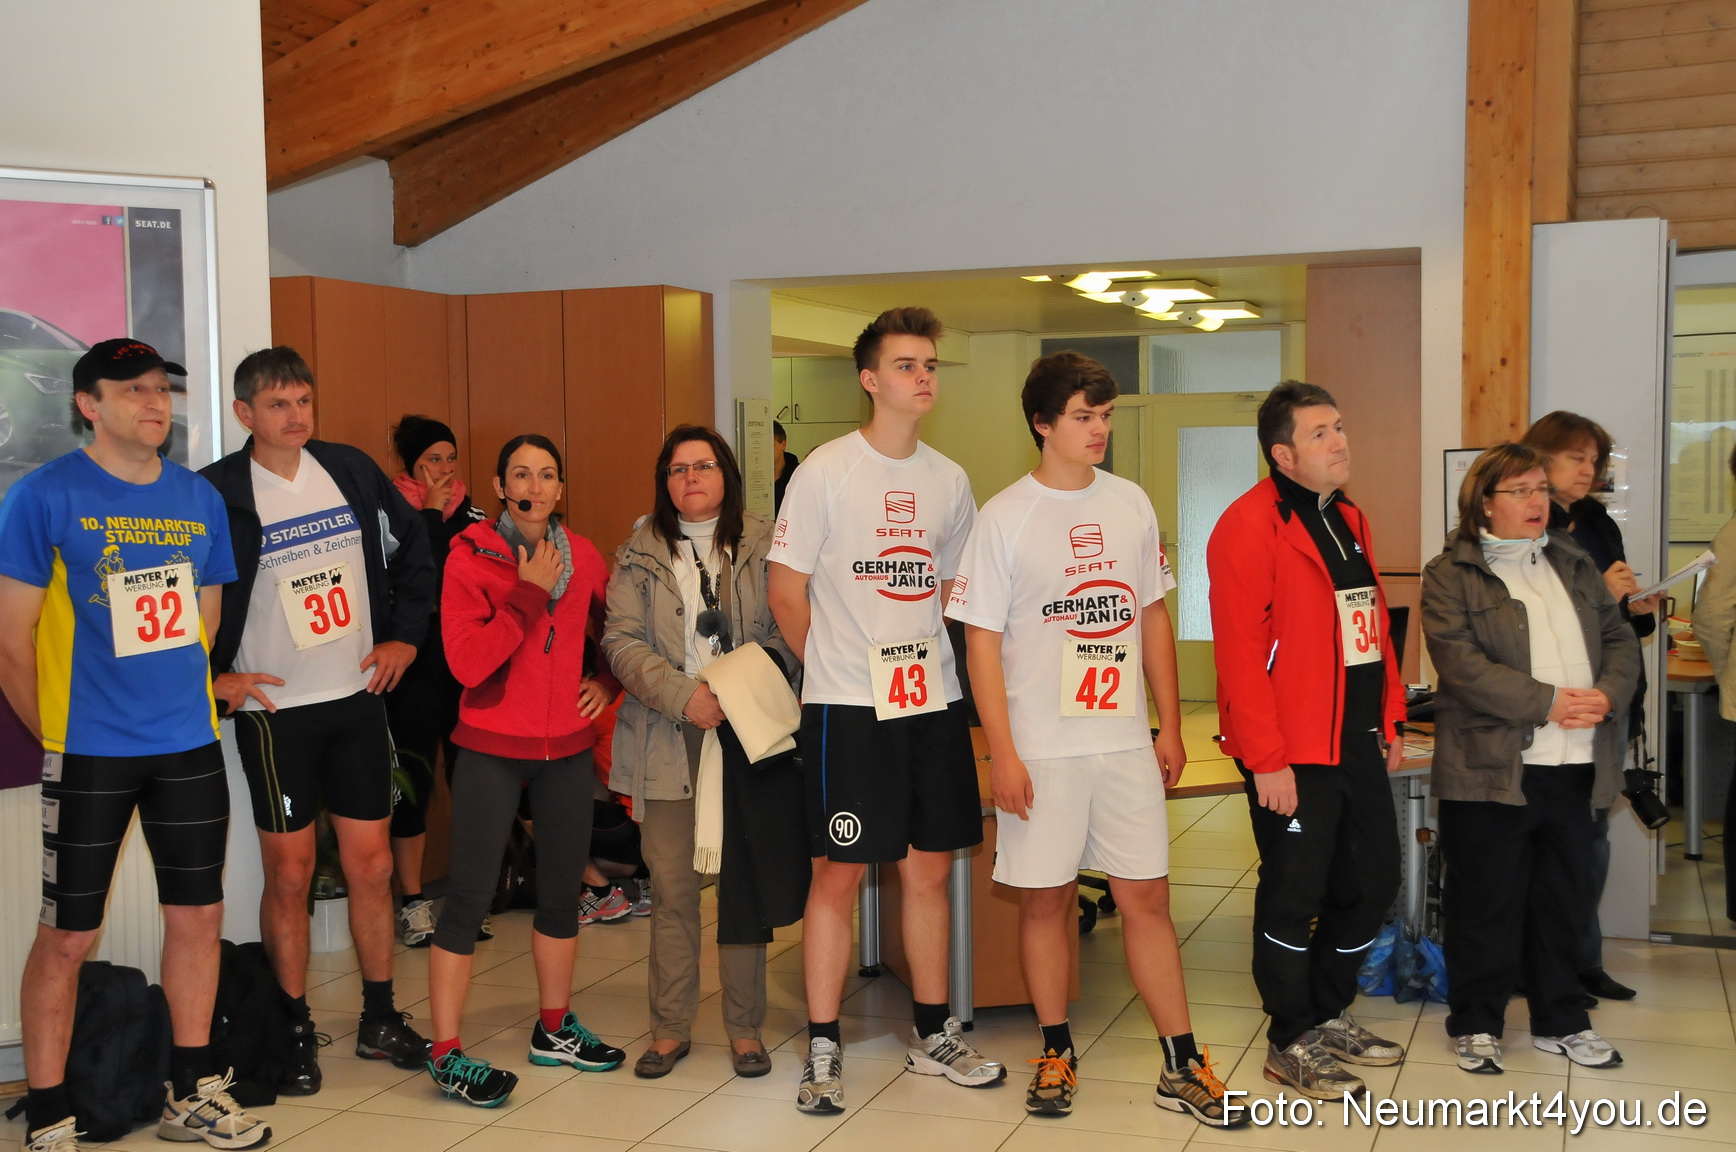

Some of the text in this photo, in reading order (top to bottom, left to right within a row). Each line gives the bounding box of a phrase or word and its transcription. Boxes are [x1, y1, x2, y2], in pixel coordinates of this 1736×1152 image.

[135, 219, 172, 229] SEAT.DE
[80, 516, 206, 536] 10. NEUMARKTER
[270, 513, 354, 544] STAEDTLER
[876, 528, 926, 538] SEAT
[105, 530, 192, 546] STADTLAUF
[260, 535, 361, 570] Schreiben & Zeichne
[852, 560, 934, 575] GERHART &
[1064, 560, 1117, 577] SEAT
[124, 571, 162, 586] MEYER
[291, 571, 328, 589] MEYER
[887, 573, 935, 588] JÄNIG
[124, 581, 165, 593] WERBUNG
[293, 580, 330, 595] WERBUNG
[1344, 590, 1369, 602] MEYER
[1345, 599, 1370, 609] WERBUNG
[304, 586, 351, 635] 30
[1042, 594, 1128, 617] GERHART &
[135, 590, 186, 643] 32
[1043, 608, 1131, 626] AUTOHAUS JÄNIG
[1351, 609, 1379, 653] 34
[881, 644, 914, 657] MEYER
[1076, 644, 1113, 654] MEYER
[1076, 653, 1113, 661] WERBUNG
[881, 653, 915, 663] WERBUNG
[888, 664, 927, 709] 43
[1075, 666, 1120, 710] 42
[835, 819, 853, 839] 90
